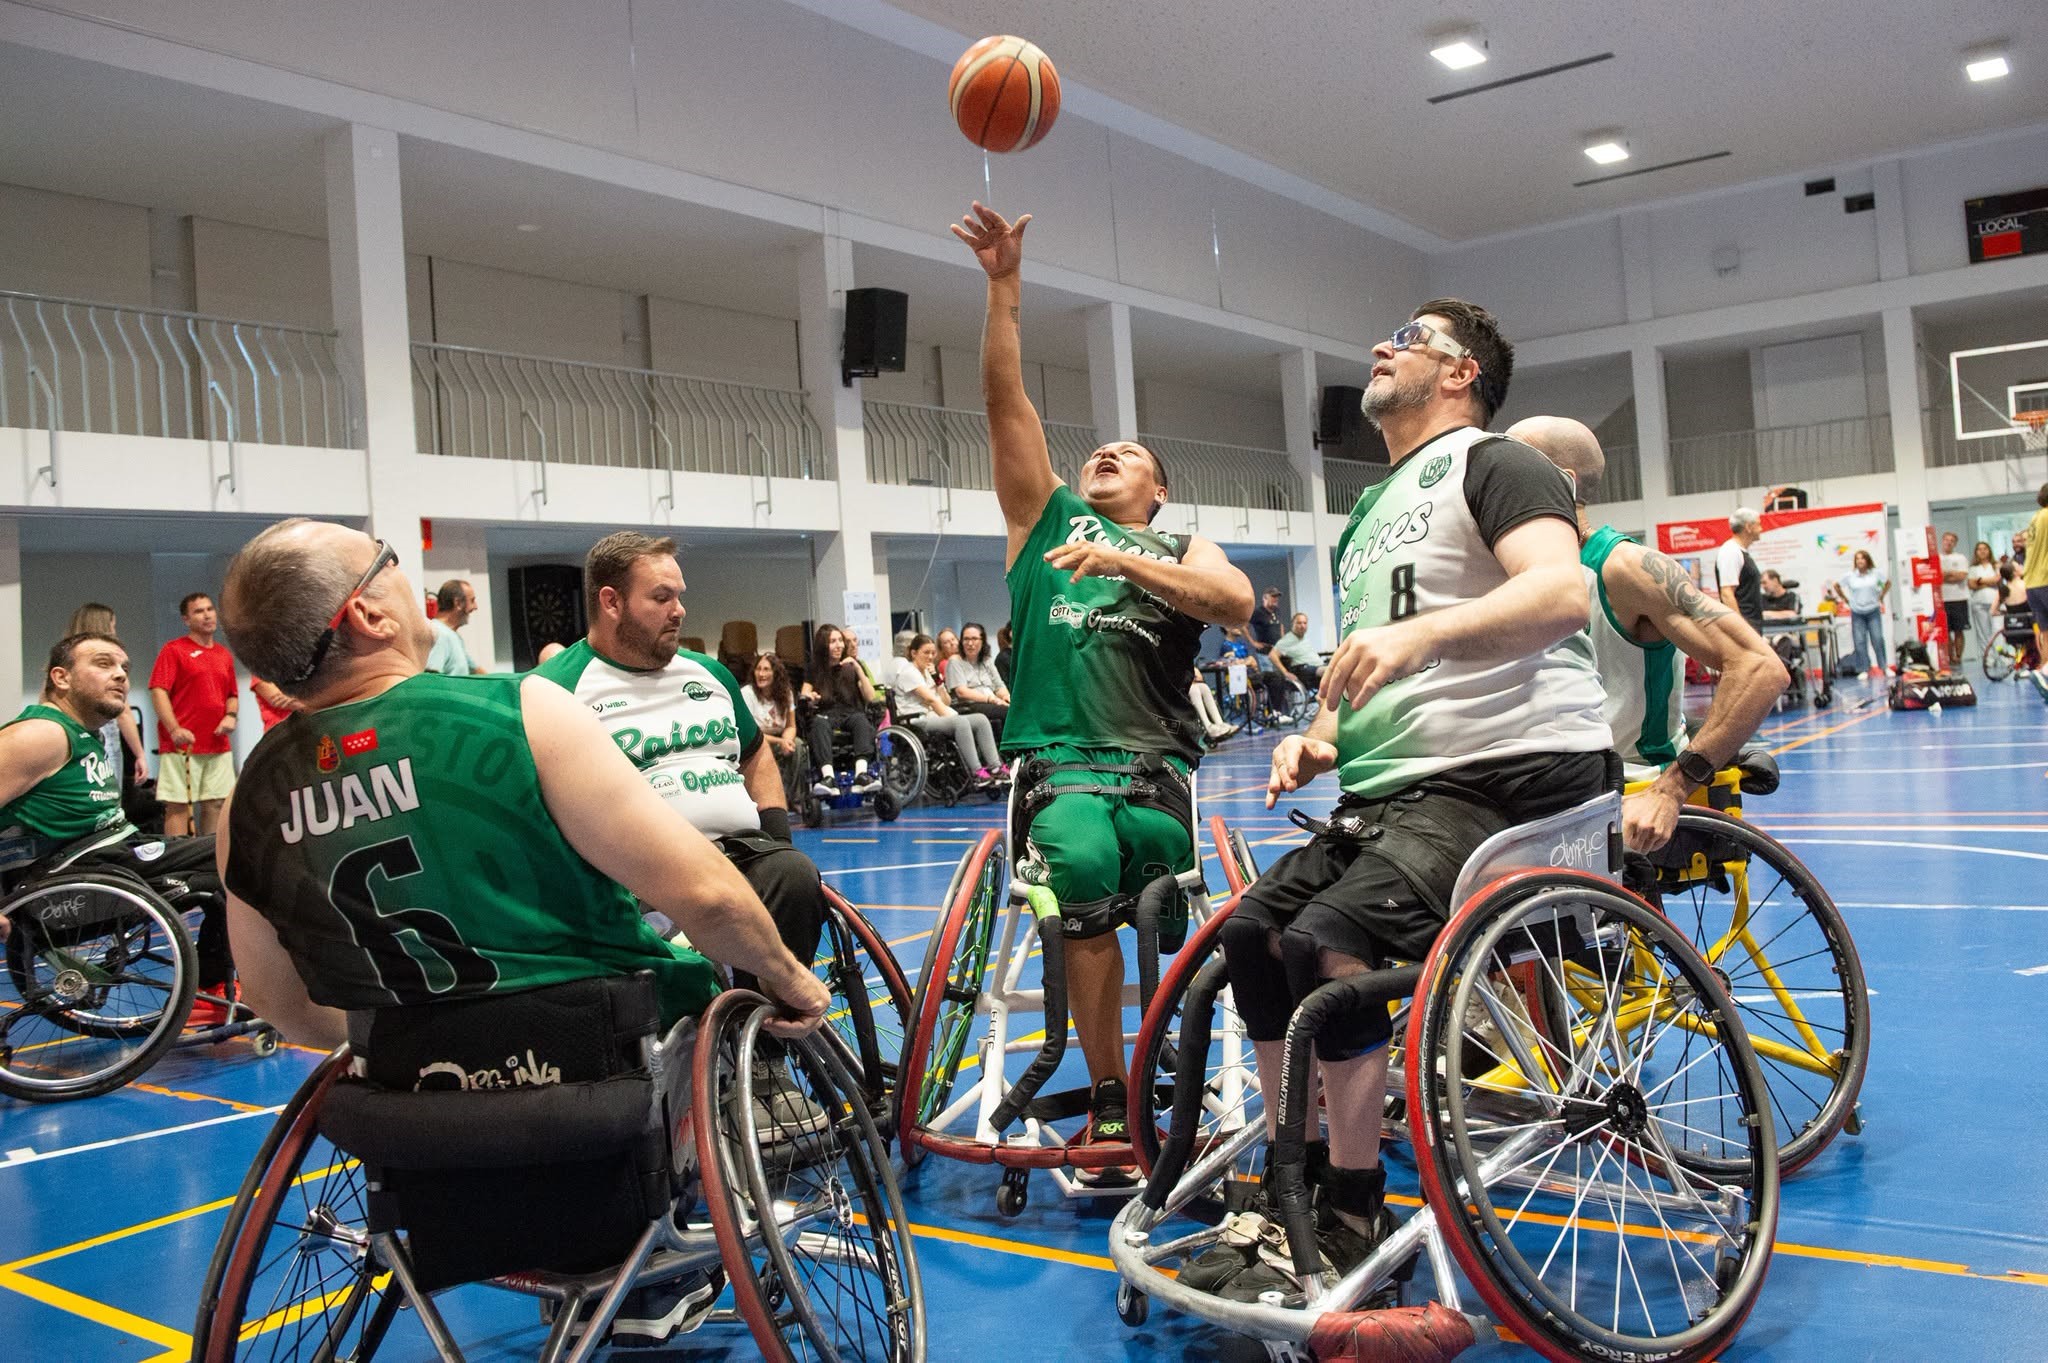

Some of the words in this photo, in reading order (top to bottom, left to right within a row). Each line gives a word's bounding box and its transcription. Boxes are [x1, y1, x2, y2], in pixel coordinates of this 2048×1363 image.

[1978, 216, 2024, 234] LOCAL
[1390, 562, 1417, 621] 8
[280, 757, 421, 845] JUAN
[327, 834, 500, 1004] 6
[1098, 1122, 1125, 1135] RGK
